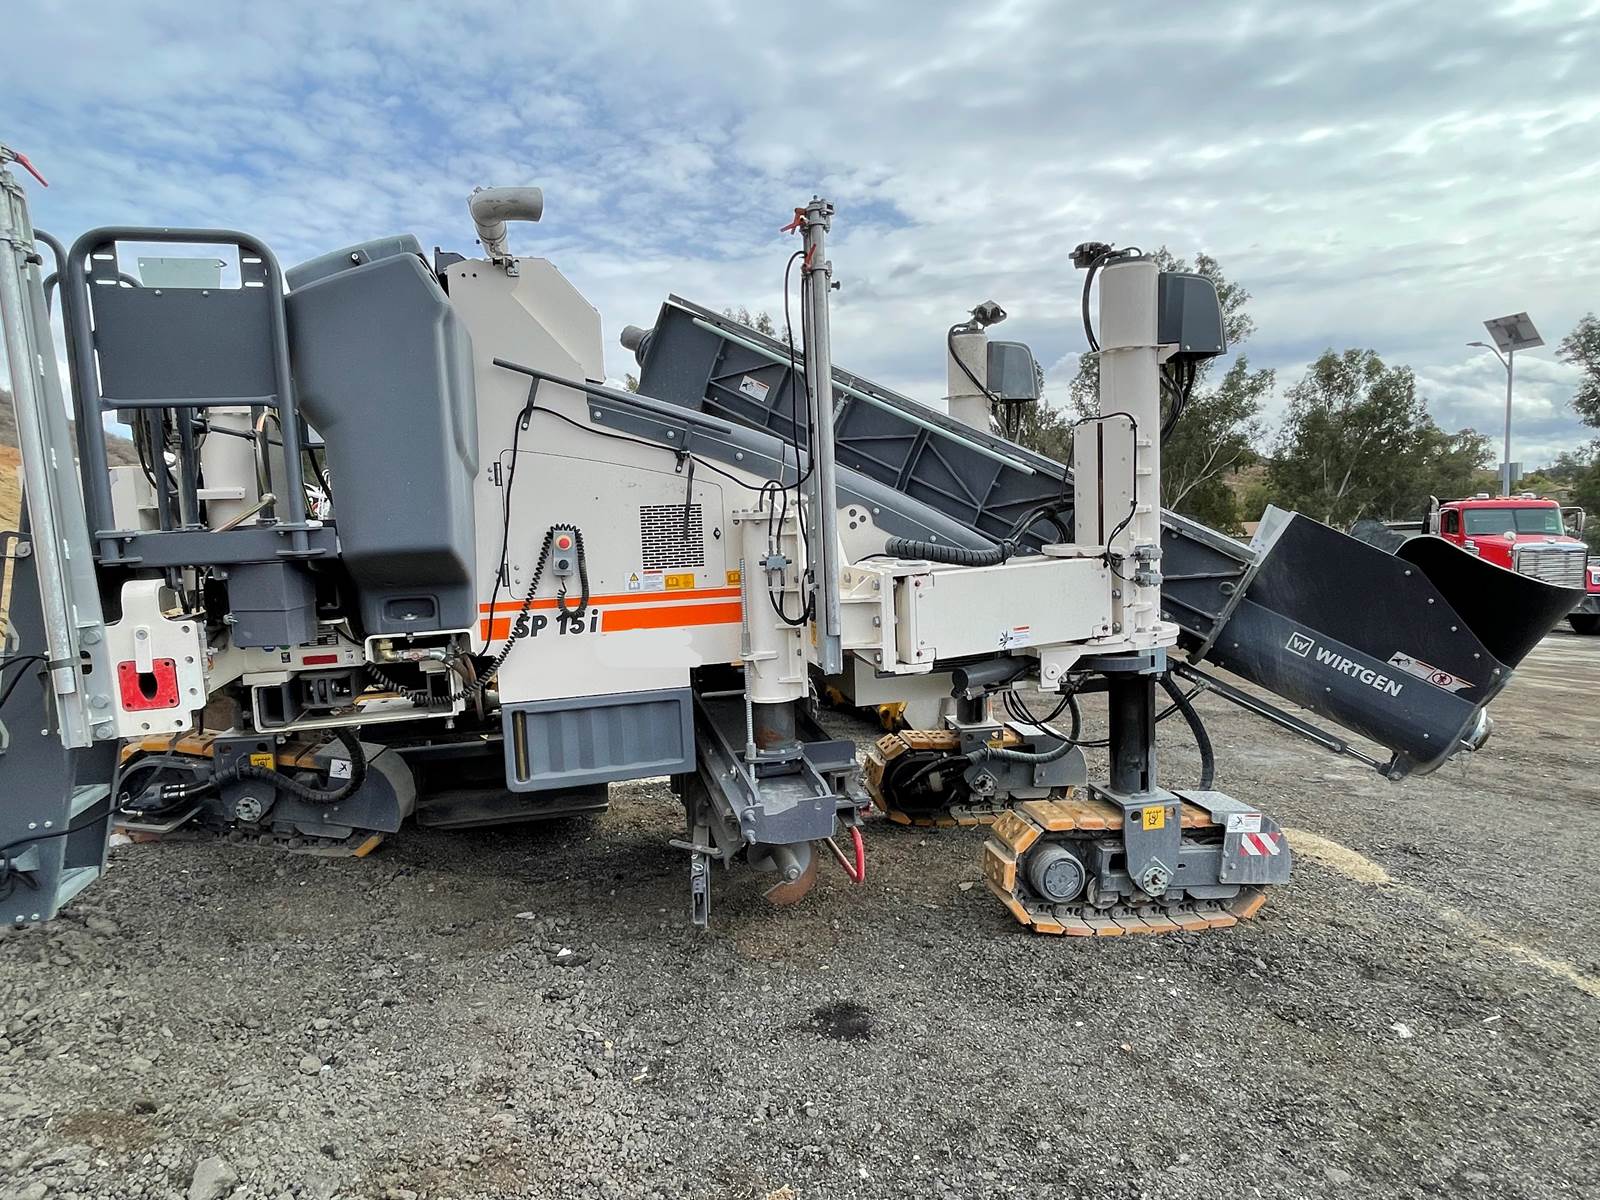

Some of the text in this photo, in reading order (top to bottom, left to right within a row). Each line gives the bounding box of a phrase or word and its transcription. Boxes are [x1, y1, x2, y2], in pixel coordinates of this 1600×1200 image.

[515, 609, 599, 638] SP 15 i
[1316, 647, 1404, 697] WIRTGEN
